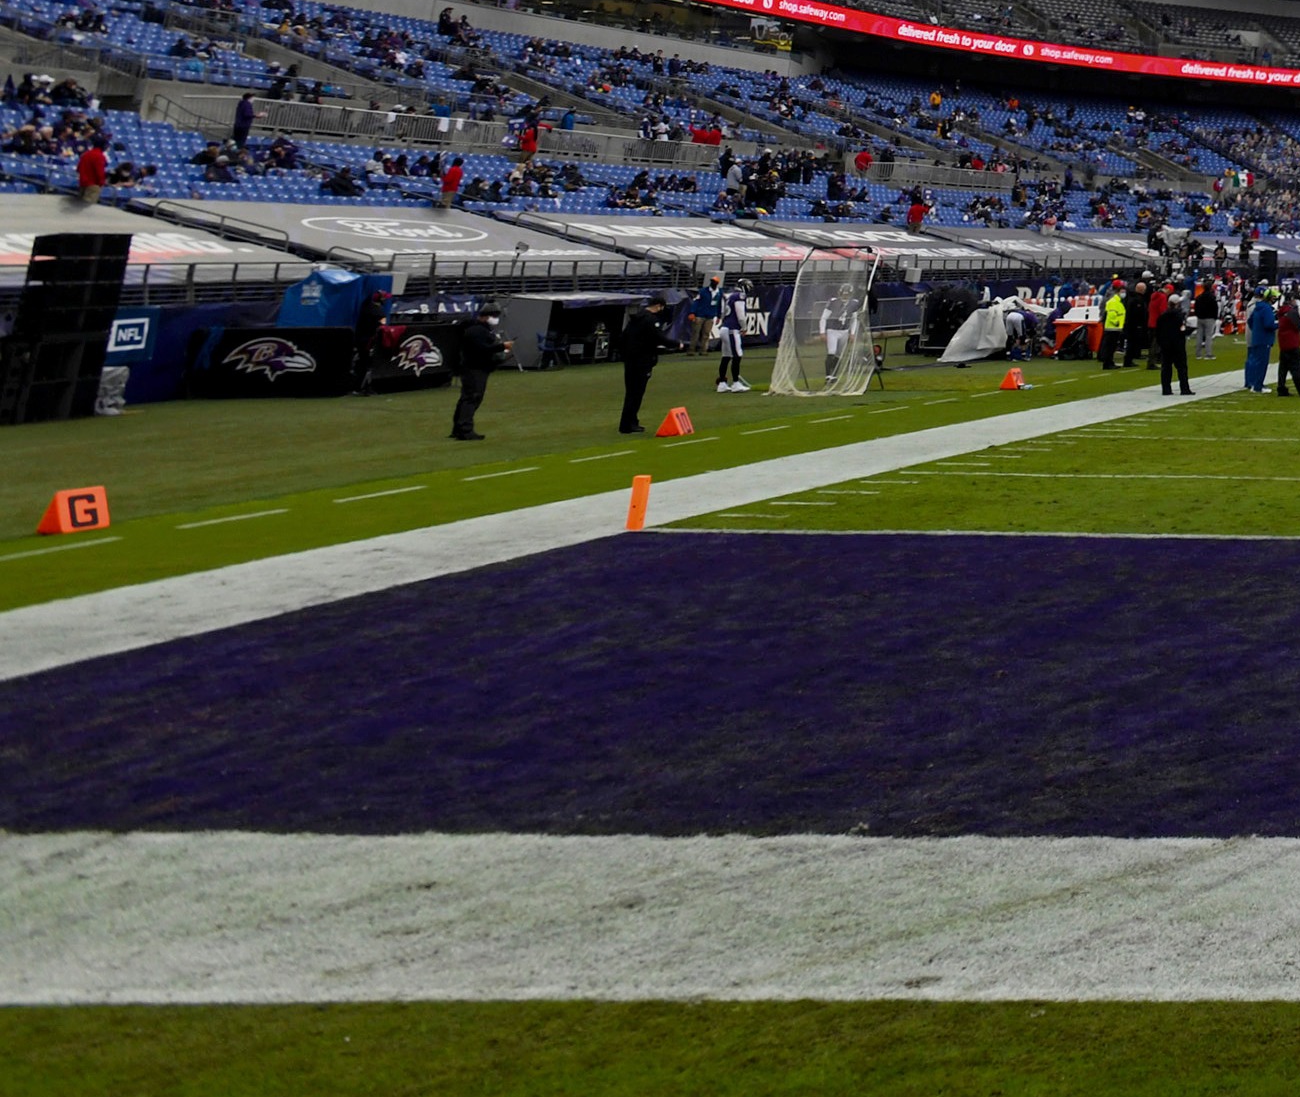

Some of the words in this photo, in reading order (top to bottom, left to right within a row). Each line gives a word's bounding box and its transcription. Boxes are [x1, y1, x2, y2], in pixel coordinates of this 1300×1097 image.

[778, 0, 846, 23] shop.safeway.com
[897, 23, 935, 42] delivered
[936, 30, 959, 45] fresh
[961, 34, 972, 47] to
[970, 37, 995, 52] your
[995, 39, 1017, 54] door
[1040, 46, 1114, 65] shop.safeway.com
[1181, 62, 1226, 78] delivered
[1226, 66, 1254, 80] fresh
[1255, 69, 1267, 81] to
[1266, 72, 1292, 84] your
[117, 327, 142, 342] NFL
[676, 410, 692, 433] 10
[67, 492, 99, 527] G
